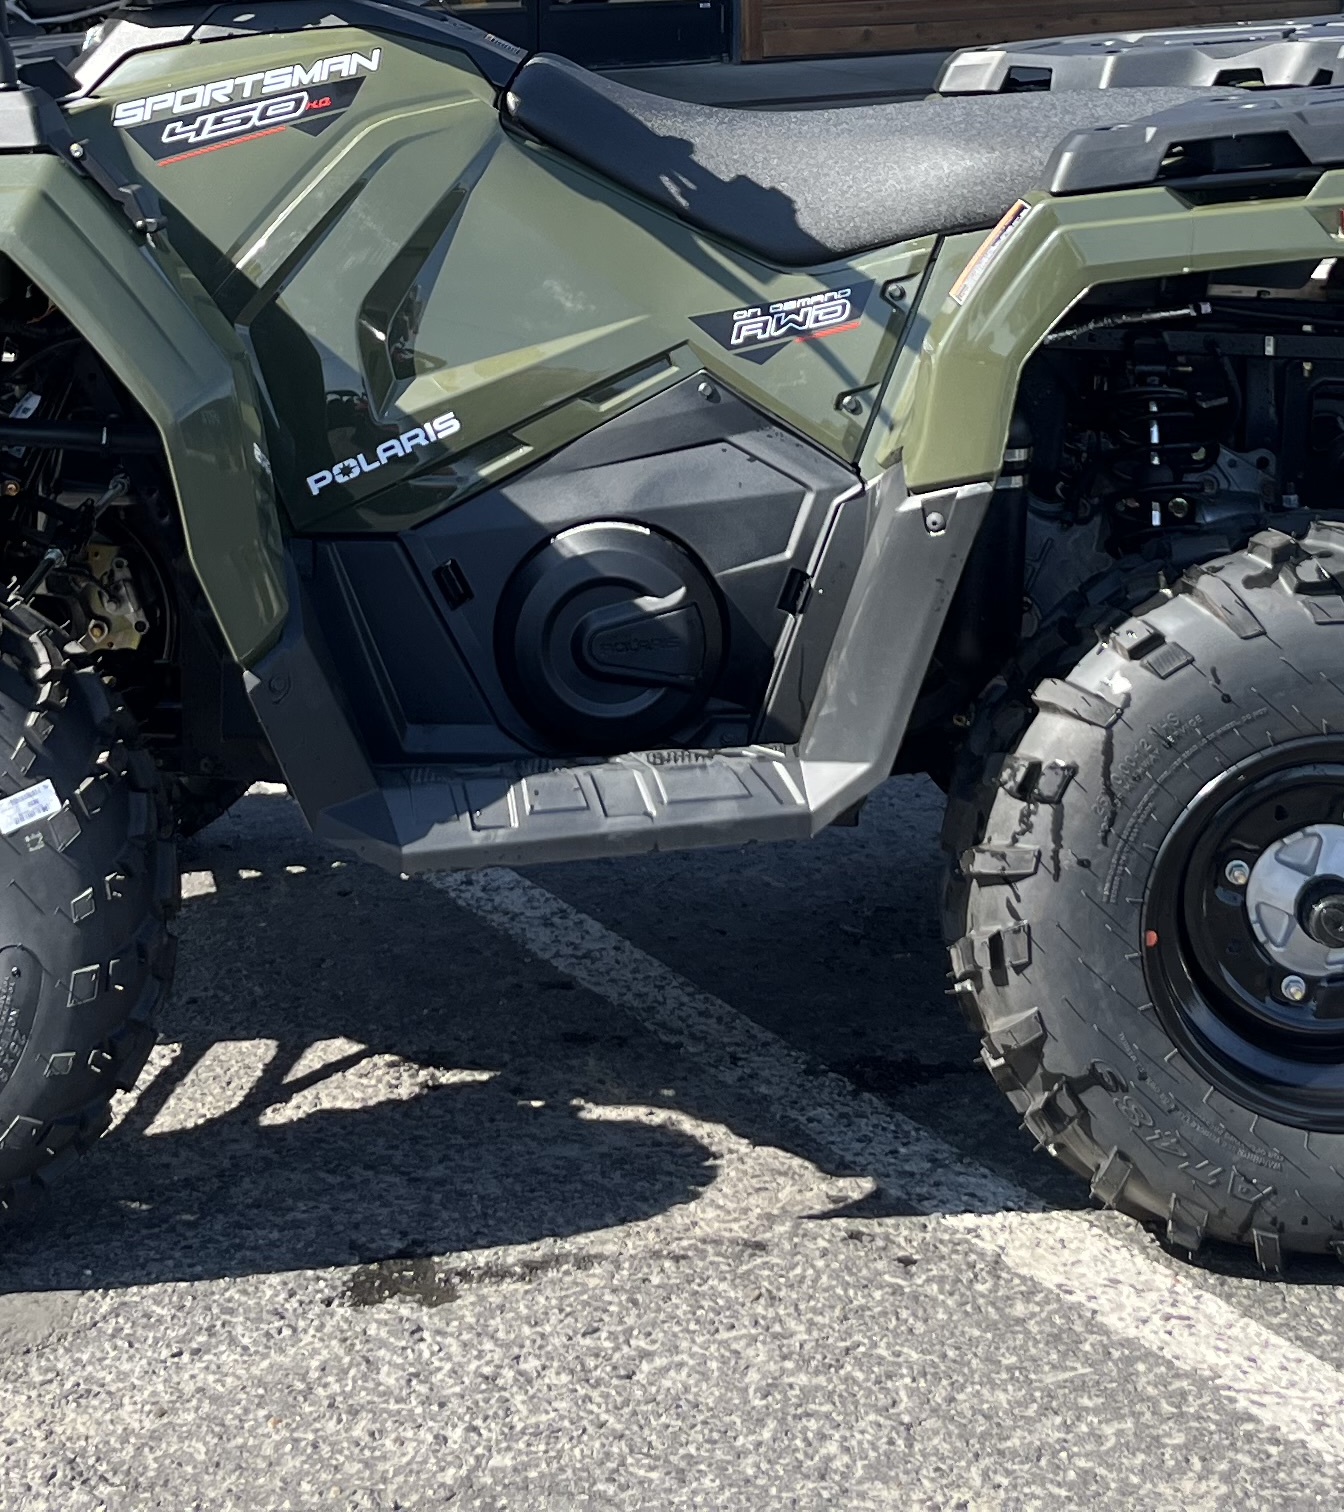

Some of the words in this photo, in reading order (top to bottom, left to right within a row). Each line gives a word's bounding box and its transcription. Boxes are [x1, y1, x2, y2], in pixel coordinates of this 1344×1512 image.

[112, 47, 382, 127] SPORTSMAN
[161, 91, 309, 144] 450
[730, 299, 851, 345] AWD
[769, 288, 851, 313] DEMAND
[306, 410, 462, 496] POLARIS
